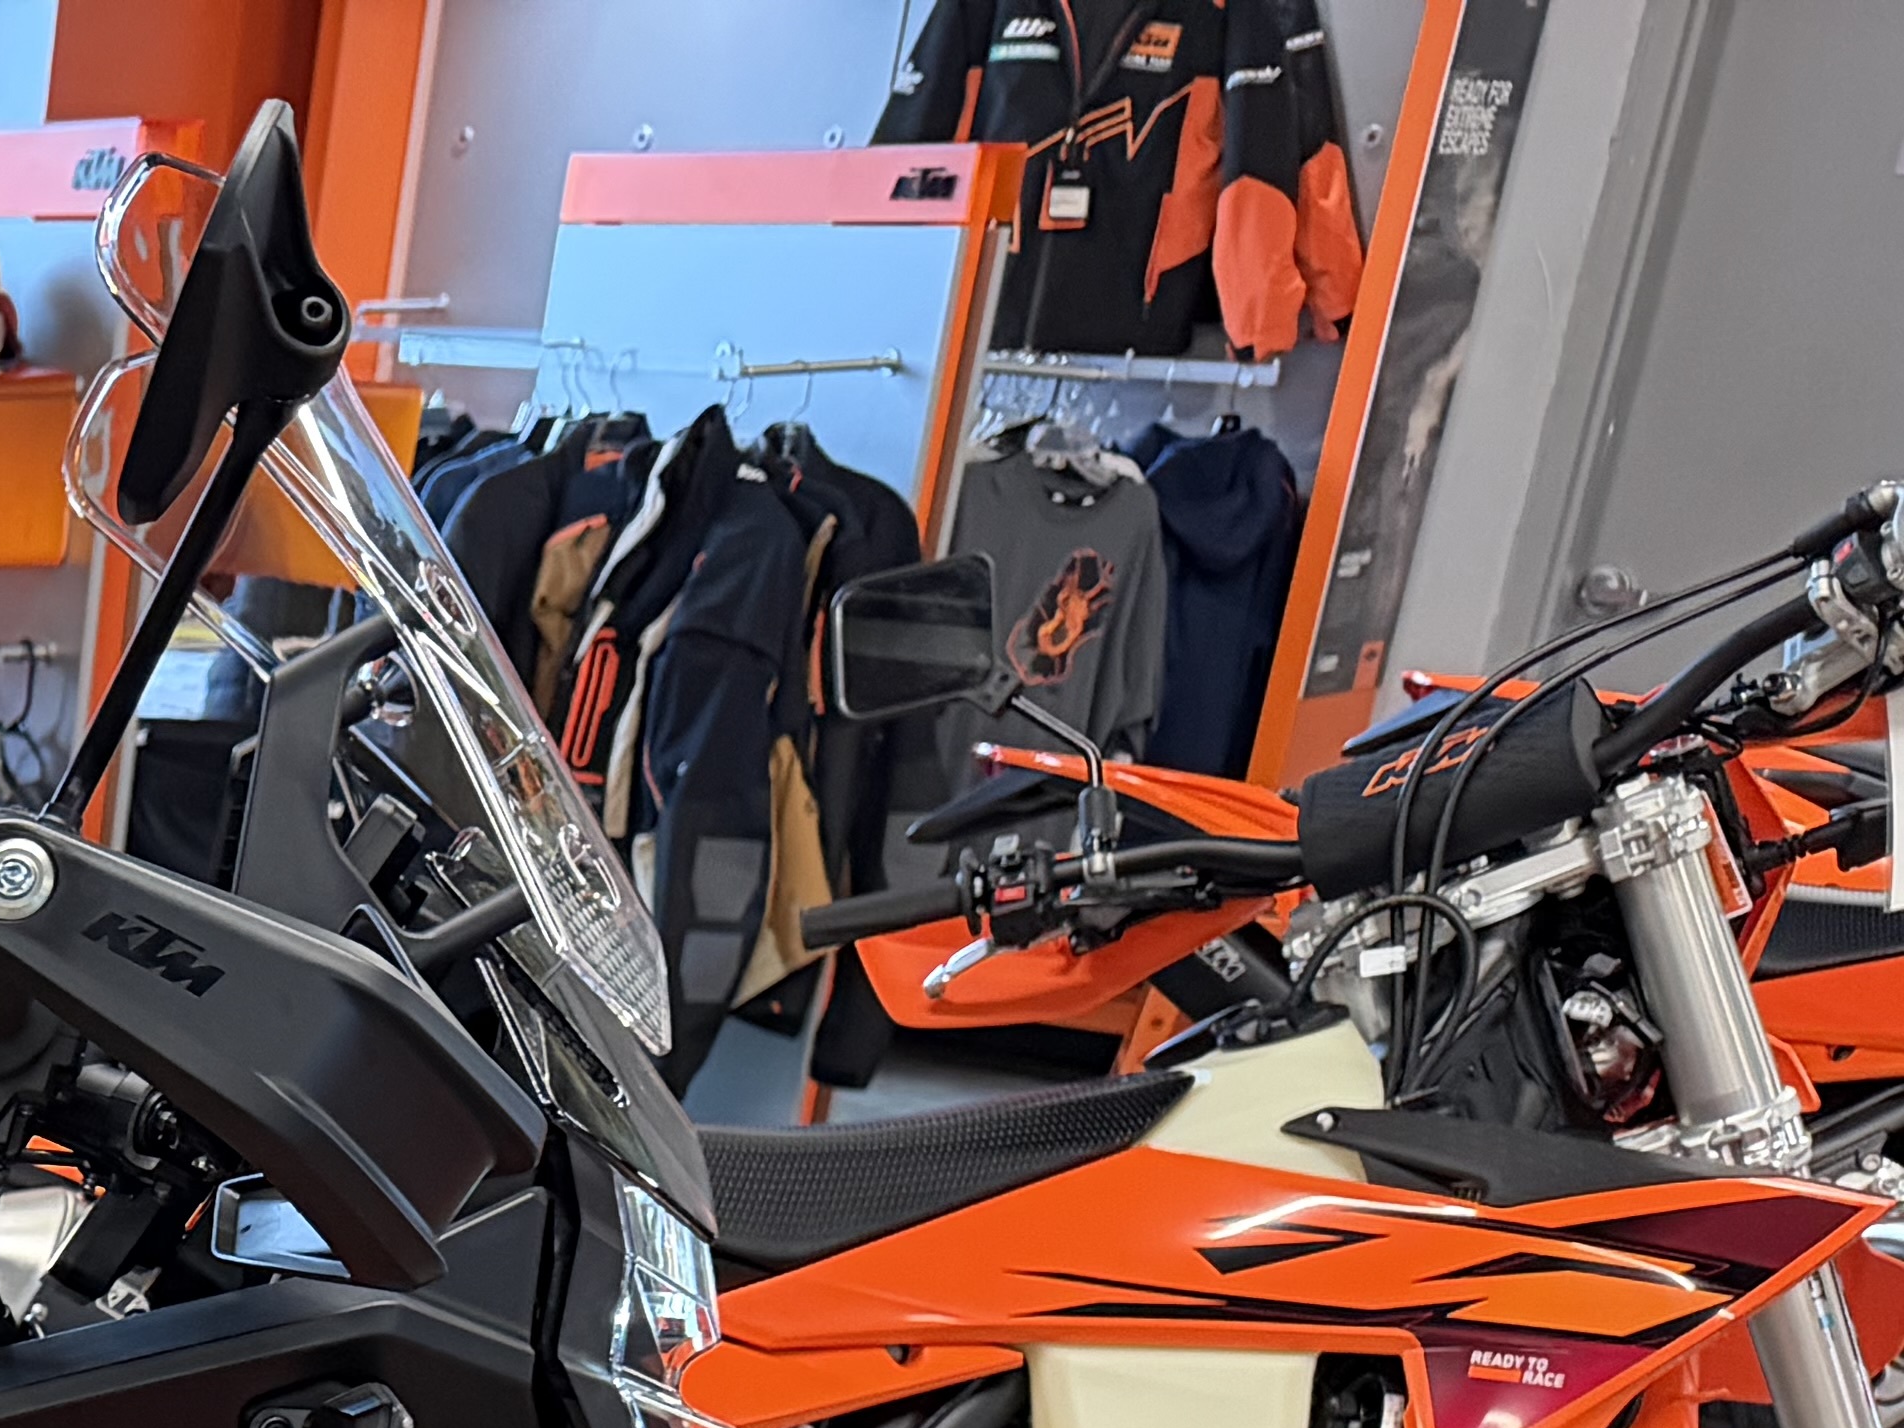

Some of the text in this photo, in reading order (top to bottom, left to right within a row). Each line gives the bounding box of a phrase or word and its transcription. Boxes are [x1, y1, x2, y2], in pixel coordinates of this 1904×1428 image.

[1452, 78, 1513, 106] READY FOR
[1445, 104, 1497, 130] EXTREME
[1439, 130, 1491, 155] ESCAPES
[890, 166, 958, 201] KTM
[80, 912, 226, 998] KTM
[1470, 1350, 1549, 1372] READY TO
[1522, 1370, 1566, 1388] RACE
